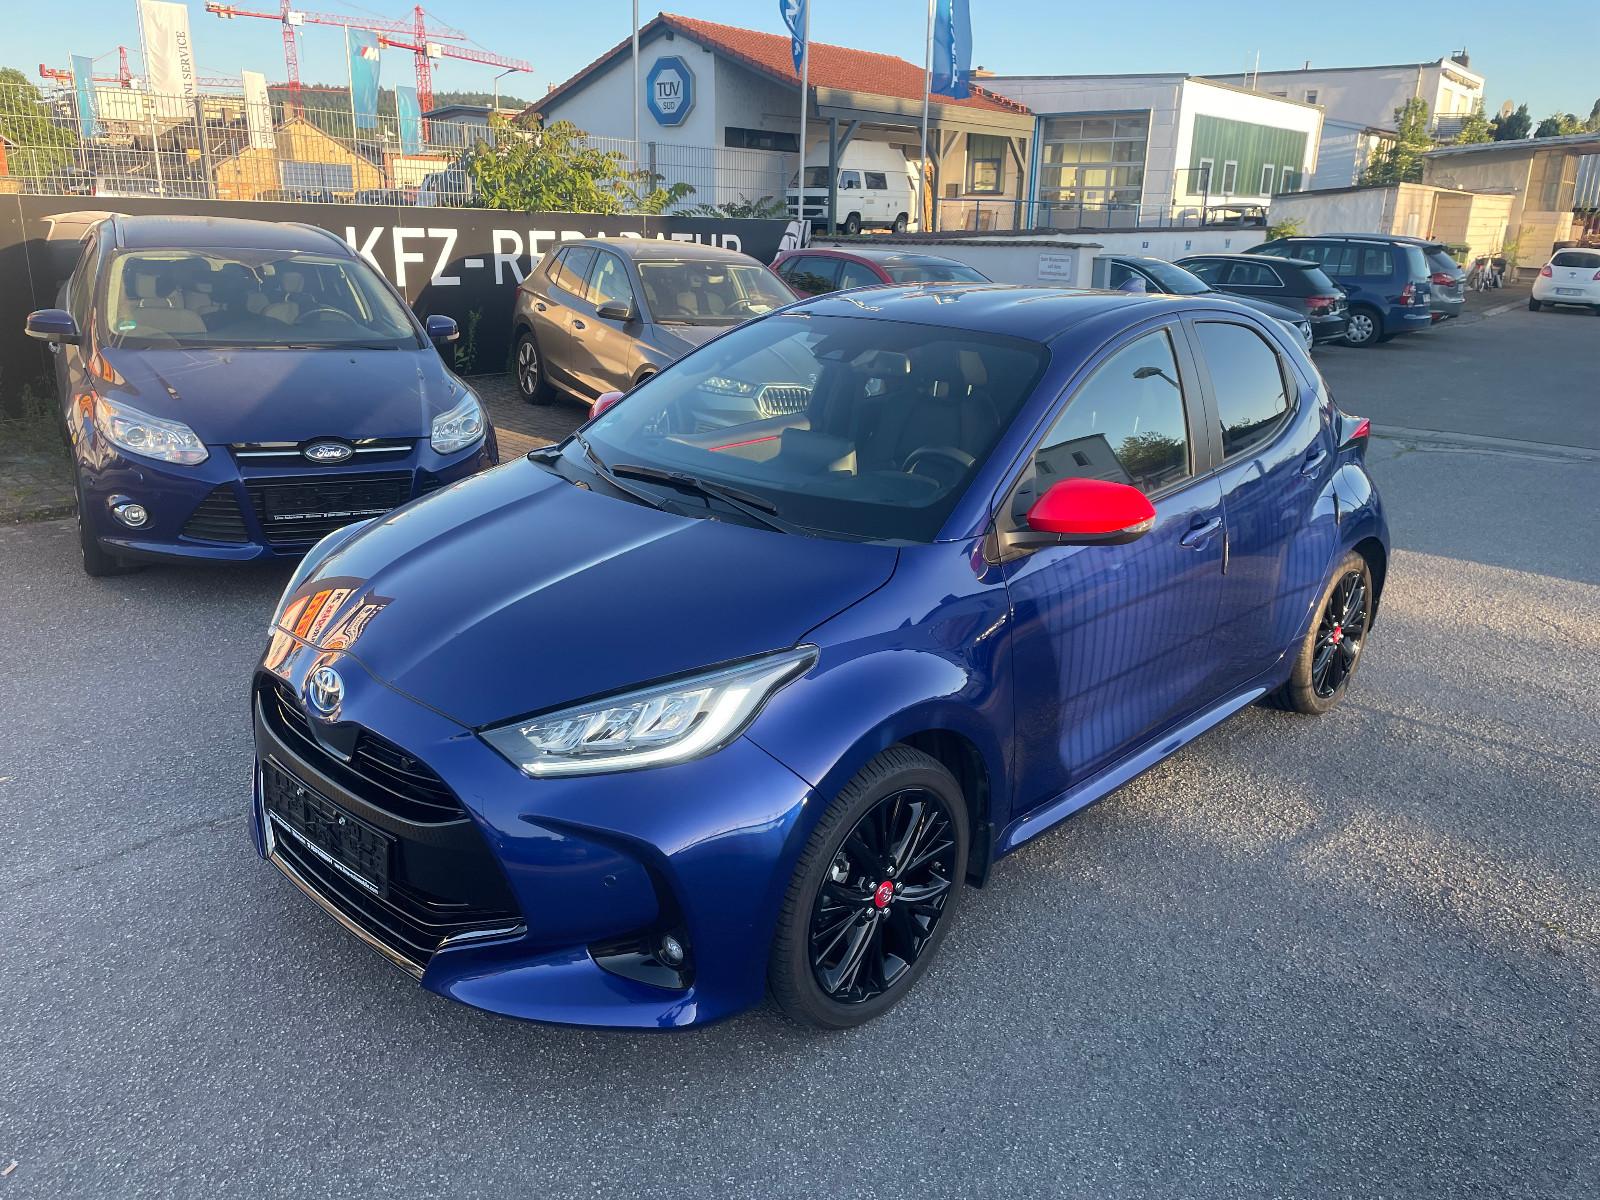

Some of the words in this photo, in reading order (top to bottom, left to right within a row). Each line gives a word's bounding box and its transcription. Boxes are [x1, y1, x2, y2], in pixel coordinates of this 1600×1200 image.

[176, 31, 192, 80] SERVICE
[656, 81, 680, 97] TÜV
[663, 101, 676, 110] SÜD
[316, 446, 342, 458] Ford
